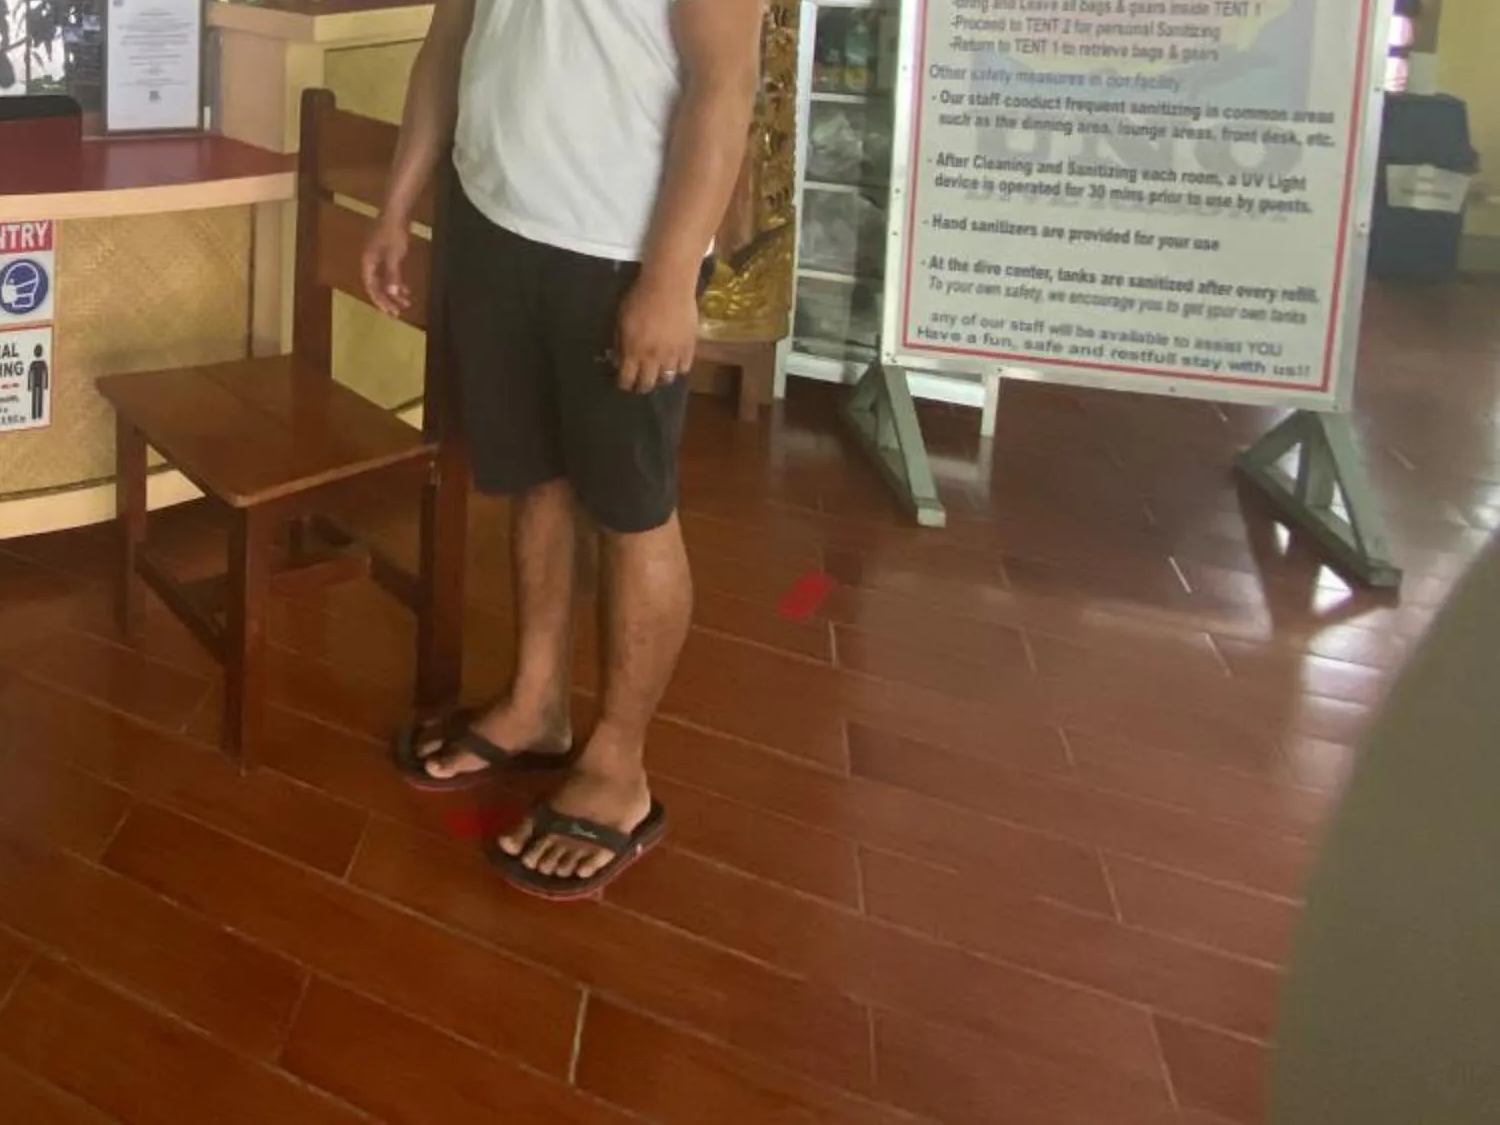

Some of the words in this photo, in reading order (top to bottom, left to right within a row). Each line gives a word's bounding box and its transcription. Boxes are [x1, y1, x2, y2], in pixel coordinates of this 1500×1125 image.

[939, 90, 964, 105] Our
[968, 92, 1001, 106] staff
[1004, 94, 1061, 109] conduct
[1065, 96, 1126, 114] frequent
[1130, 101, 1201, 120] sanitizing
[1205, 105, 1219, 118] in
[1223, 108, 1288, 121] common
[1291, 110, 1334, 123] areas
[936, 151, 969, 167] After
[973, 154, 1033, 176] Cleaning
[1037, 160, 1062, 174] and
[1067, 160, 1138, 183] Sanitizing
[1142, 168, 1177, 182] each
[1242, 173, 1264, 187] UV
[1268, 175, 1307, 193] Light
[935, 173, 978, 190] device
[983, 177, 994, 190] is
[999, 178, 1060, 196] operated
[1065, 182, 1084, 197] for
[1109, 186, 1143, 202] mins
[1148, 189, 1182, 205] prior
[1188, 192, 1202, 204] to
[1205, 194, 1232, 208] use
[1237, 194, 1254, 212] by
[932, 214, 967, 230] Hand
[971, 219, 1037, 236] sanitizers
[1042, 224, 1064, 238] are
[1068, 226, 1130, 244] provided
[1134, 231, 1154, 245] for
[1158, 236, 1191, 251] your
[1193, 238, 1220, 251] use
[928, 255, 943, 270] At
[948, 256, 969, 273] the
[1057, 267, 1096, 284] tanks
[1101, 274, 1124, 287] are
[1129, 275, 1194, 293] sanitized
[1198, 278, 1233, 295] after
[917, 326, 961, 342] Have
[967, 332, 976, 343] a
[1024, 338, 1063, 353] safe
[1068, 341, 1103, 357] and
[1180, 355, 1223, 371] stay
[1227, 359, 1266, 374] with
